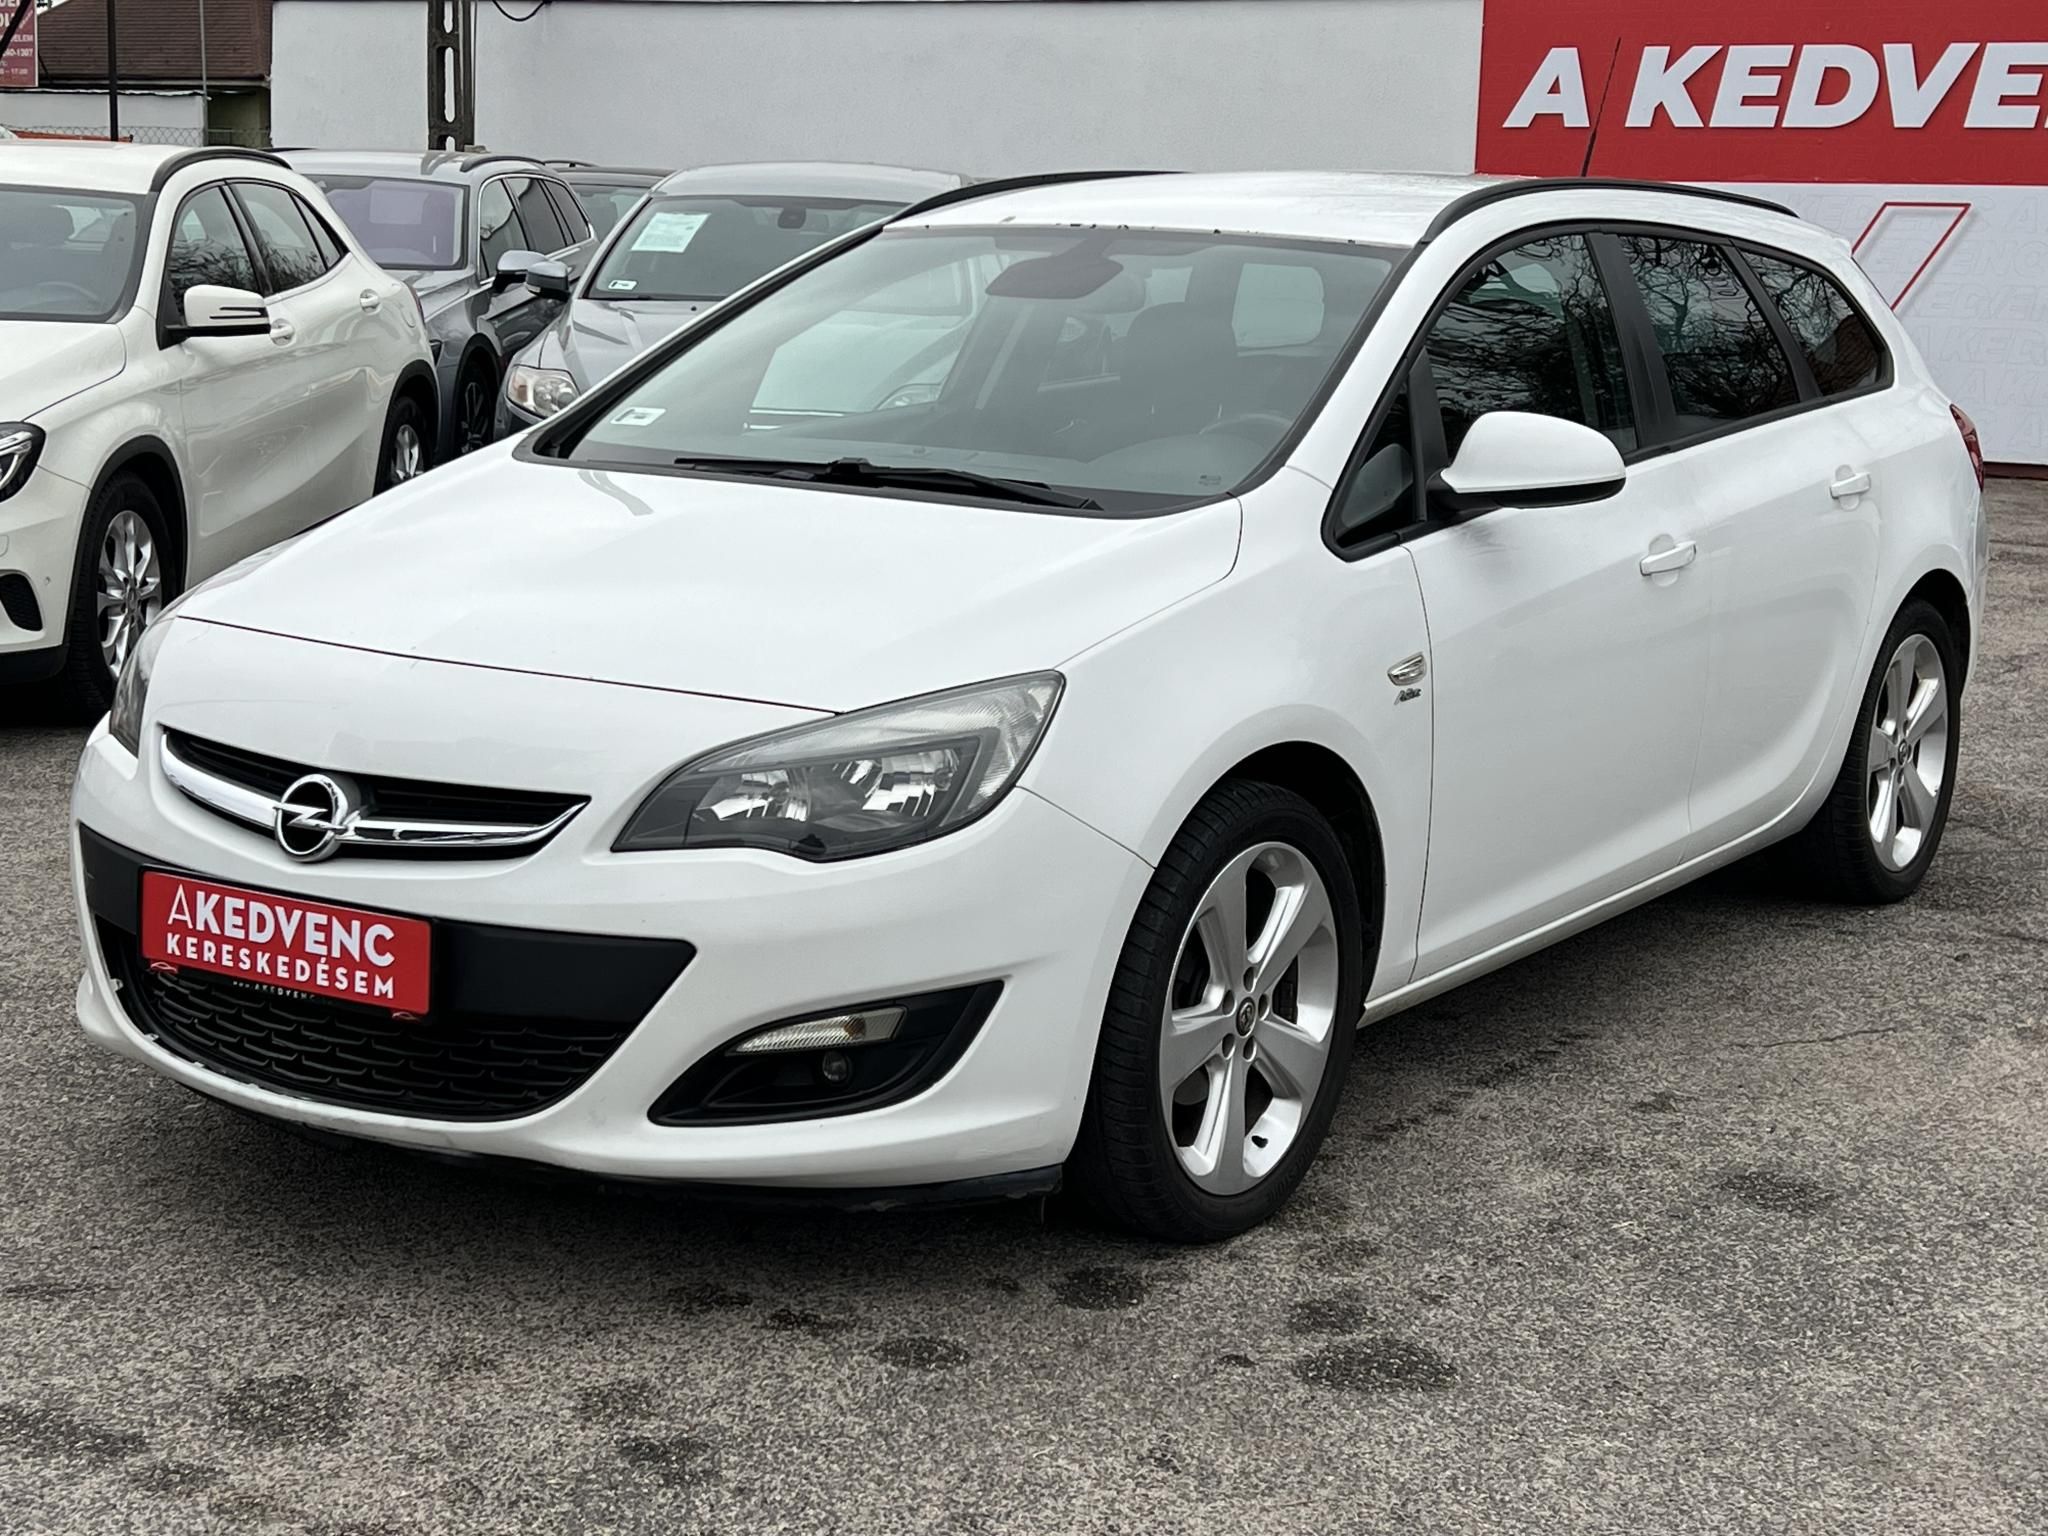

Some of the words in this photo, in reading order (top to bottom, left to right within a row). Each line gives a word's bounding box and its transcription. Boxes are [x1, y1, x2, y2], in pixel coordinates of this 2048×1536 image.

[1502, 47, 1590, 128] A
[1625, 42, 2048, 128] KEDVE
[166, 932, 394, 999] KERESKEDÉSEM
